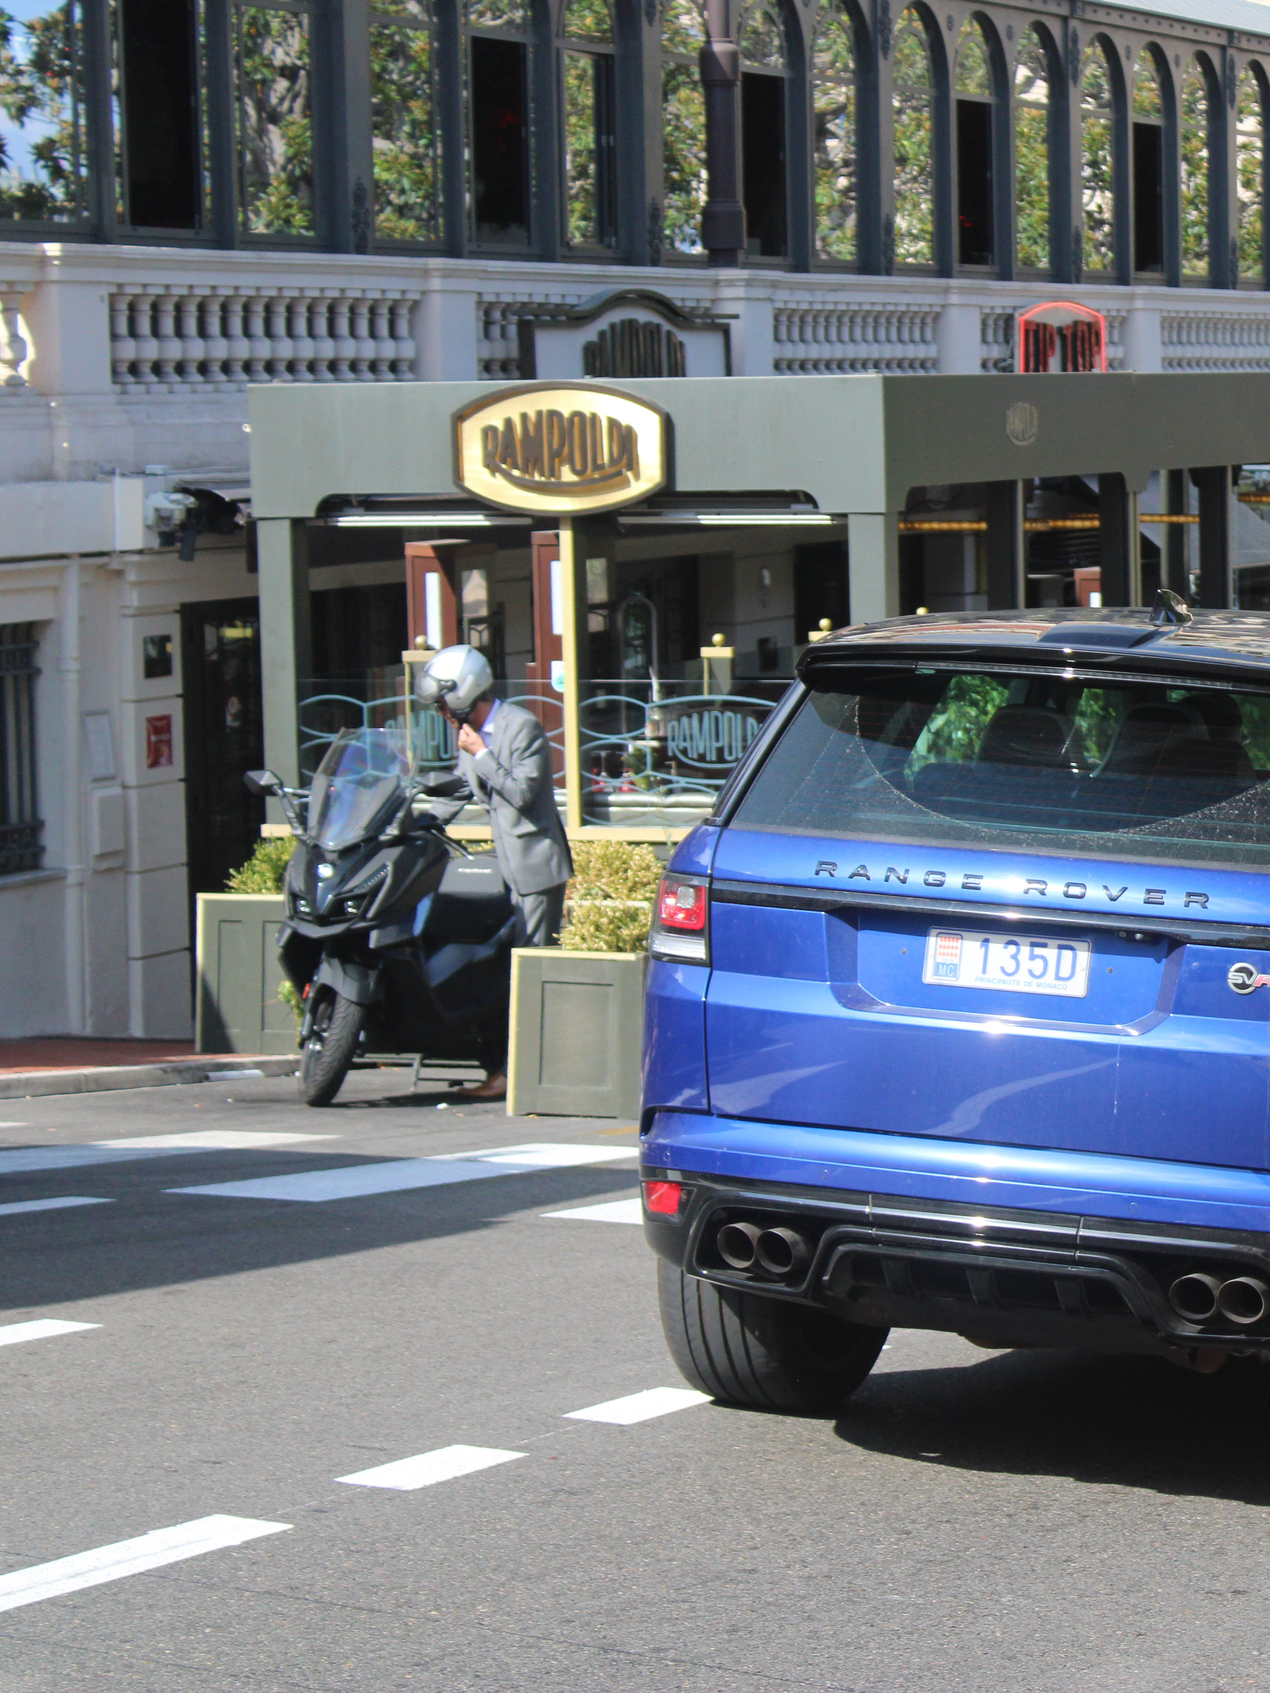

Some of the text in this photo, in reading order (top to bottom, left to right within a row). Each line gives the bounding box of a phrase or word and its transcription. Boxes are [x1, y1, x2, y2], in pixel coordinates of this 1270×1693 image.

[480, 408, 640, 482] RAMPOLDI
[666, 710, 764, 761] RAMPOLD
[814, 859, 1210, 910] RANGE ROVER
[938, 964, 954, 976] MC
[979, 937, 1078, 981] 135D
[1036, 981, 1068, 990] MONACO
